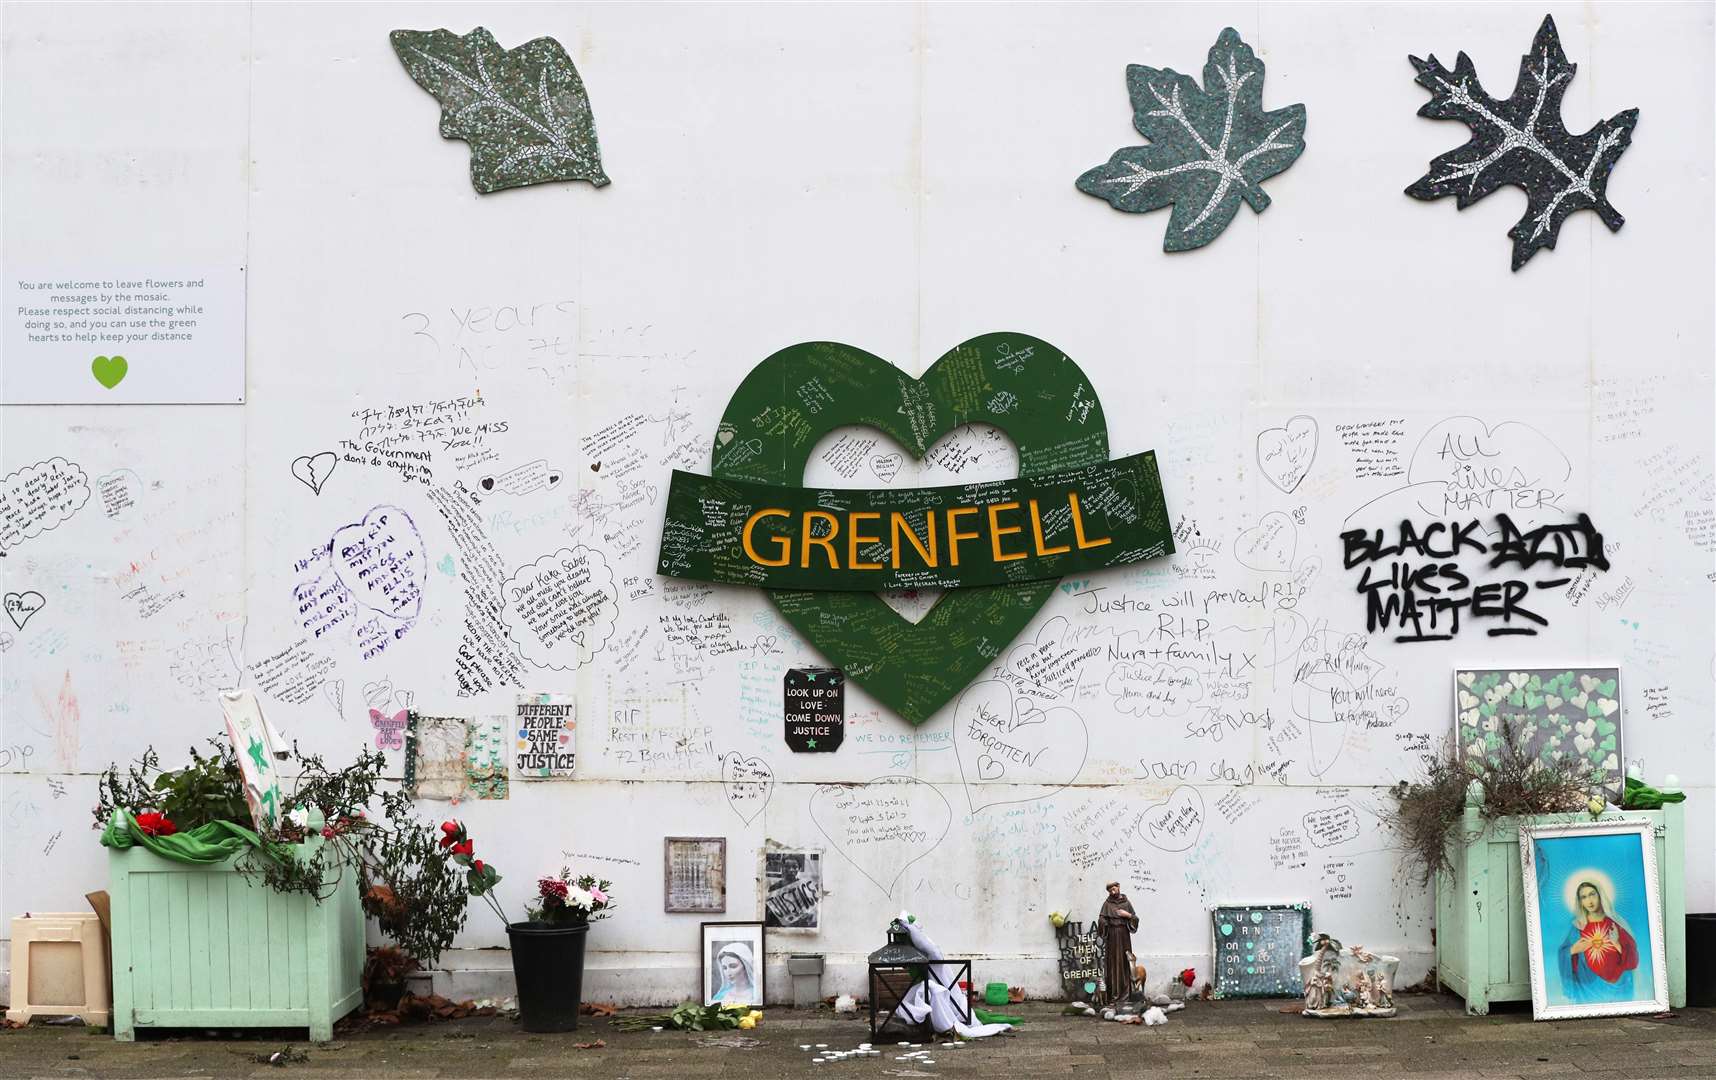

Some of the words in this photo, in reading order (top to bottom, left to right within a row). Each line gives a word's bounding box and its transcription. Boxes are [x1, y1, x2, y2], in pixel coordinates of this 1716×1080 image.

[18, 281, 35, 290] You
[56, 280, 100, 289] welcome
[103, 281, 113, 289] to
[116, 280, 142, 288] leave
[146, 279, 183, 288] flowers
[187, 279, 203, 288] and
[51, 294, 97, 304] messages
[101, 293, 112, 304] by
[115, 293, 131, 301] the
[135, 293, 169, 301] mosaic.
[18, 307, 50, 315] Please
[53, 307, 90, 317] respect
[93, 306, 121, 315] social
[125, 305, 173, 316] distancing
[176, 305, 203, 314] while
[25, 320, 50, 331] doing
[54, 321, 67, 330] so,
[70, 320, 86, 328] and
[90, 320, 107, 330] you
[150, 319, 165, 327] the
[169, 320, 196, 329] green
[28, 333, 59, 342] hearts
[75, 333, 96, 343] help
[100, 333, 123, 343] keep
[127, 334, 148, 343] your
[152, 332, 192, 340] distance
[452, 426, 471, 436] We
[339, 440, 361, 451] The
[365, 442, 431, 461] Government
[1437, 433, 1501, 460] ALL
[344, 454, 366, 465] don't
[371, 457, 381, 466] do
[387, 460, 432, 477] anything
[25, 472, 47, 488] dearly
[403, 472, 416, 483] for
[1447, 462, 1540, 490] Lives
[28, 483, 46, 496] dearly
[1444, 488, 1565, 516] MATTER
[1292, 506, 1308, 520] RIP
[742, 492, 1112, 570] GRENFELL
[1340, 519, 1488, 570] BLACK
[1358, 561, 1469, 593] LIVES
[512, 582, 534, 602] Dear
[535, 572, 561, 587] Kaka
[527, 596, 535, 605] all
[537, 586, 552, 598] miss
[554, 579, 566, 590] you
[567, 568, 591, 580] dearly
[522, 607, 535, 619] and
[536, 600, 548, 610] still
[548, 589, 566, 602] can't
[568, 577, 591, 590] believe
[574, 608, 586, 616] look
[586, 595, 608, 616] forward
[1074, 587, 1153, 614] Justice
[1162, 589, 1194, 608] will
[1204, 582, 1268, 614] prevail
[532, 621, 548, 634] Your
[550, 609, 567, 623] smile
[569, 602, 581, 611] was
[582, 589, 603, 603] always
[537, 607, 553, 617] have
[555, 597, 567, 609] lost
[1366, 580, 1549, 637] MATTER
[575, 618, 587, 627] love
[691, 625, 702, 635] you
[719, 623, 731, 633] day
[1158, 613, 1209, 640] RIP
[483, 643, 493, 655] THE
[1030, 652, 1038, 661] in
[1038, 640, 1056, 655] peace
[459, 644, 475, 660] God
[471, 662, 492, 687] please
[506, 660, 518, 673] THE
[1025, 661, 1040, 674] gone
[1042, 652, 1052, 664] but
[456, 658, 474, 676] work
[473, 678, 489, 693] your
[1030, 666, 1047, 679] never
[787, 689, 809, 697] LOOK
[813, 689, 824, 698] UP
[827, 689, 838, 697] ON
[1330, 687, 1351, 709] You
[1355, 685, 1374, 700] will
[517, 705, 572, 716] DIFFERENT
[976, 701, 1006, 733] NEVER
[1335, 710, 1346, 722] be
[786, 714, 811, 722] COME
[815, 714, 842, 726] DOWN,
[528, 730, 557, 741] SAME
[793, 727, 829, 735] JUSTICE
[856, 735, 872, 743] WE
[880, 734, 895, 743] DO
[900, 731, 950, 744] REMEMBER
[968, 719, 1048, 768] FORGOTTEN
[517, 753, 574, 769] JUSTICE
[616, 751, 633, 763] 72
[768, 879, 819, 919] JUSTICE
[1077, 933, 1096, 942] TELL
[1072, 945, 1099, 954] THEM
[1226, 942, 1238, 950] on
[1080, 956, 1091, 964] OF
[1227, 955, 1239, 963] on
